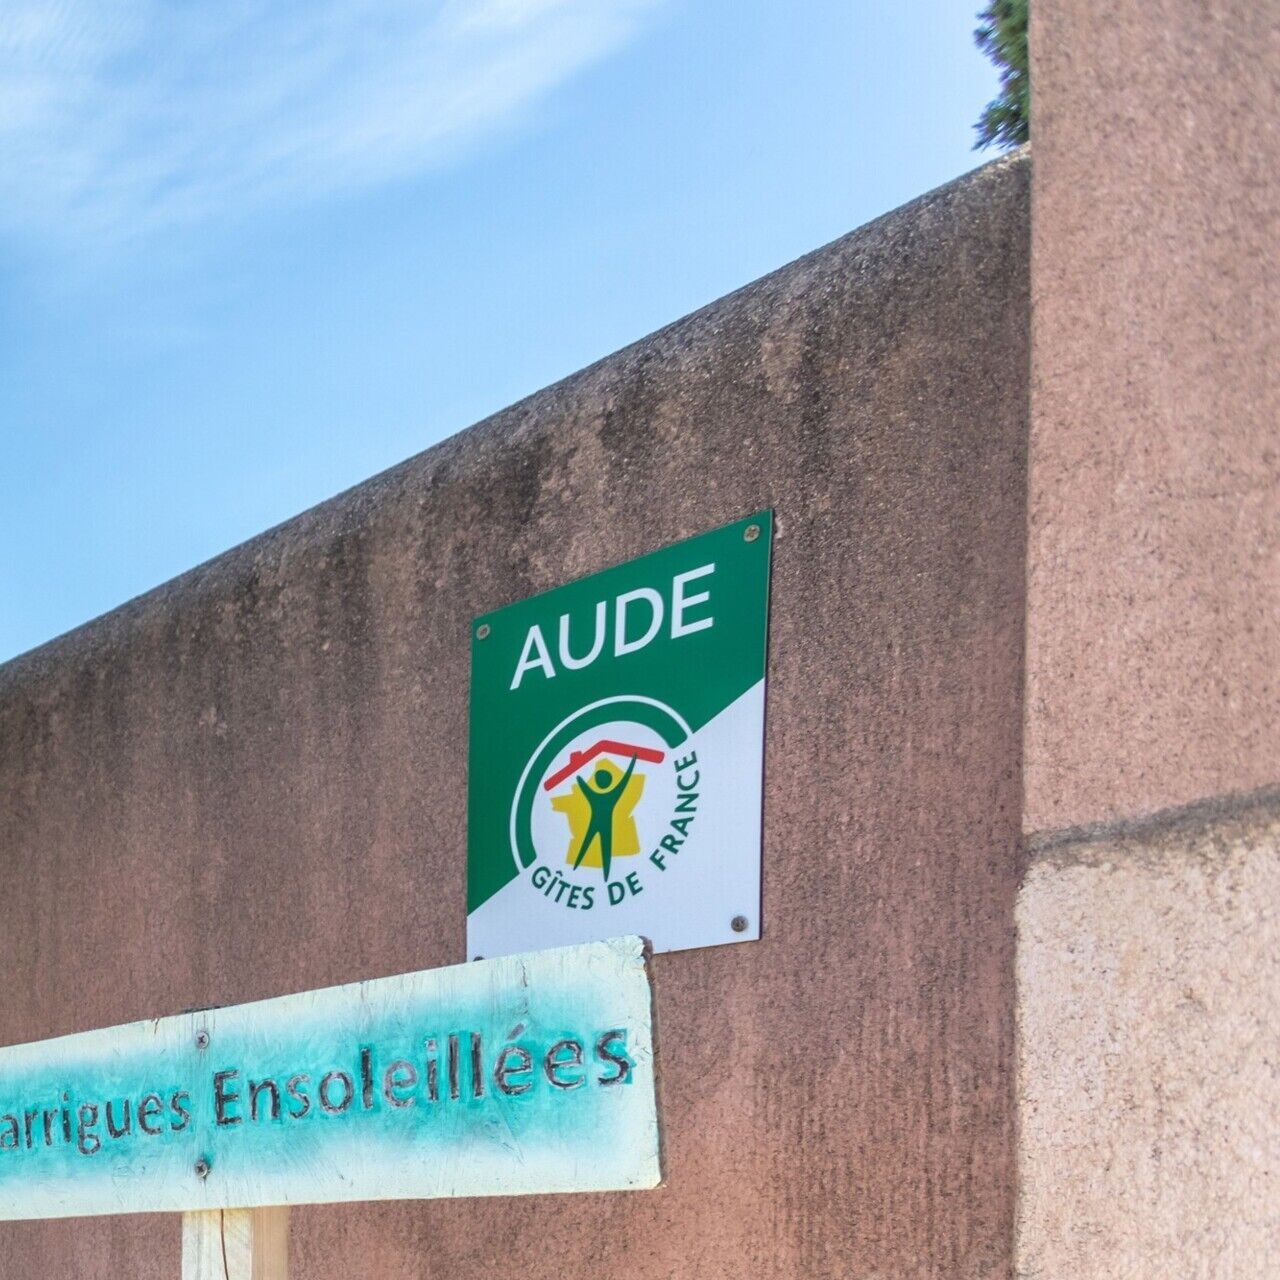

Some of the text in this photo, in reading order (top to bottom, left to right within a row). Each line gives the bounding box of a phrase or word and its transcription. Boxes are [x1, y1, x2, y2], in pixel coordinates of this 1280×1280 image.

[509, 562, 716, 691] AUDE
[531, 750, 700, 911] GÎTES DE FRANCE
[213, 1022, 633, 1127] Ensoleillées
